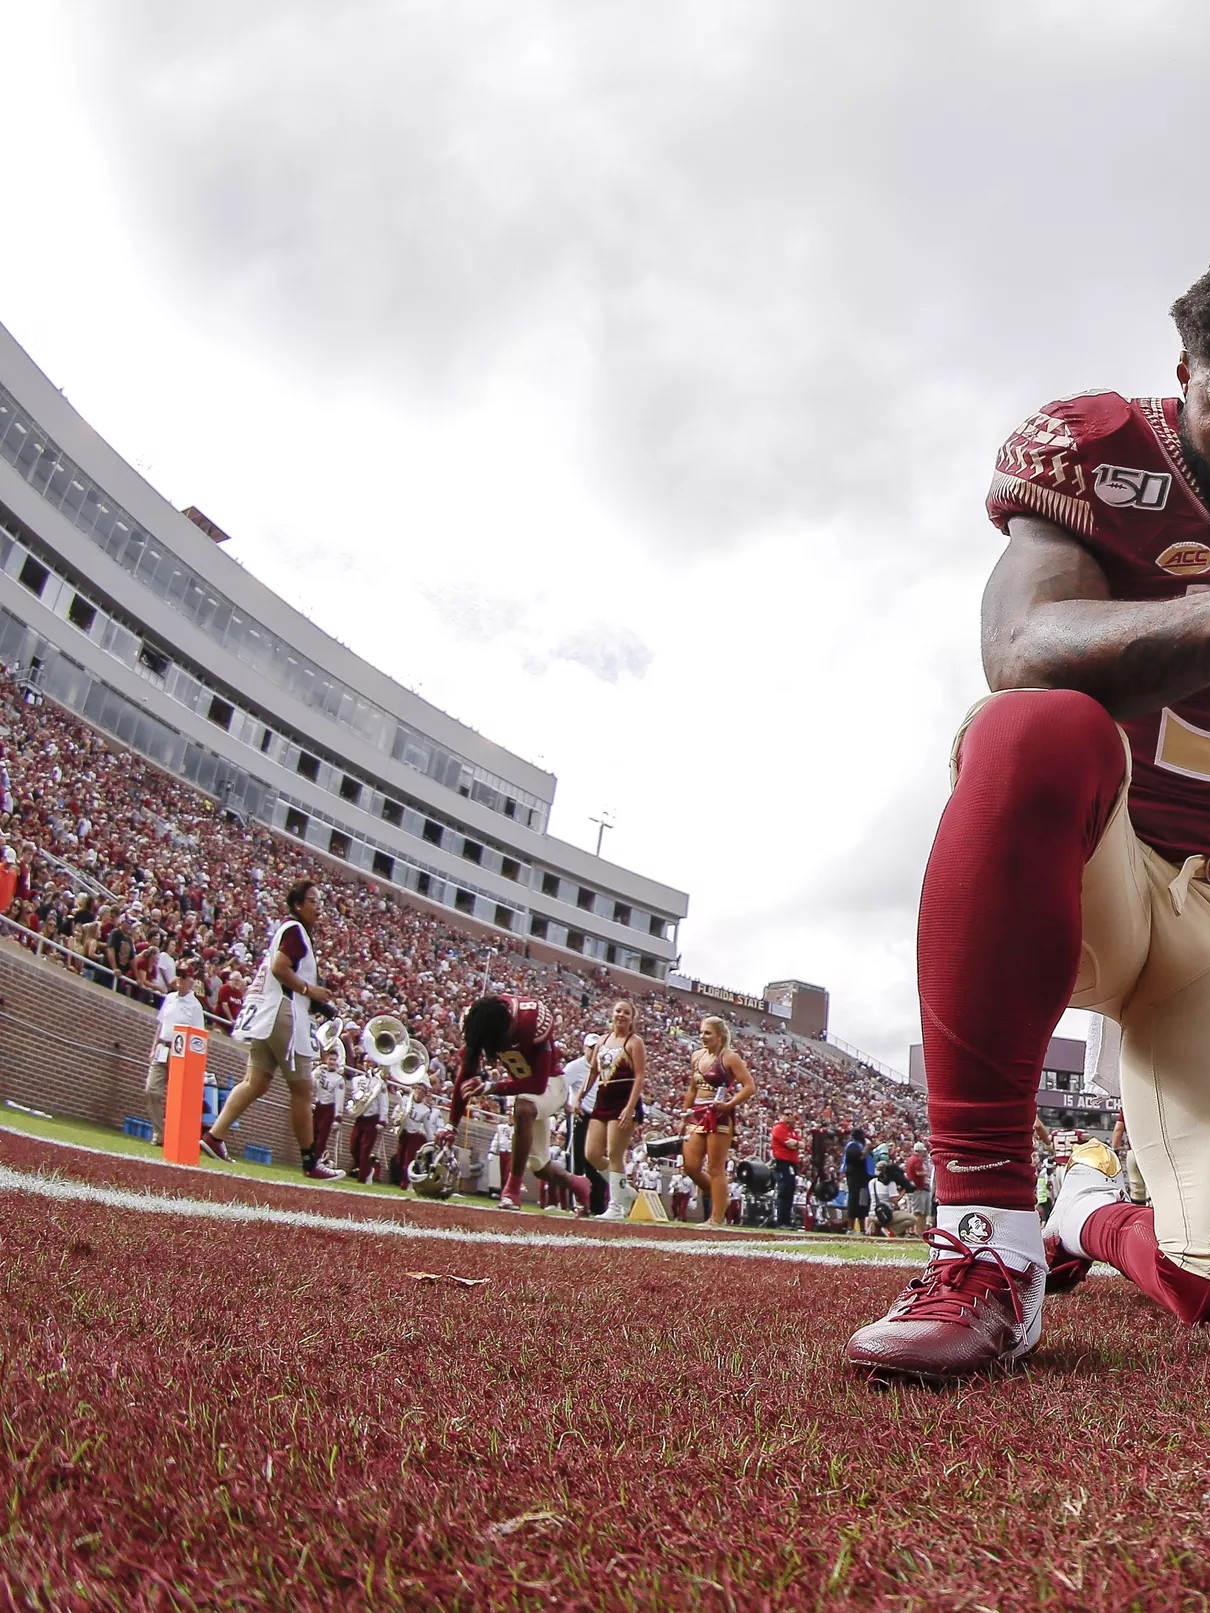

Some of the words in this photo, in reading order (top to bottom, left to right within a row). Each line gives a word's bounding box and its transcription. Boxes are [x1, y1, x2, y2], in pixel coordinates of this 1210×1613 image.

[1093, 464, 1172, 510] 150
[1164, 549, 1210, 566] ACC
[697, 983, 734, 1003] FLORIDA
[736, 995, 765, 1011] STATE
[498, 1050, 533, 1079] 8
